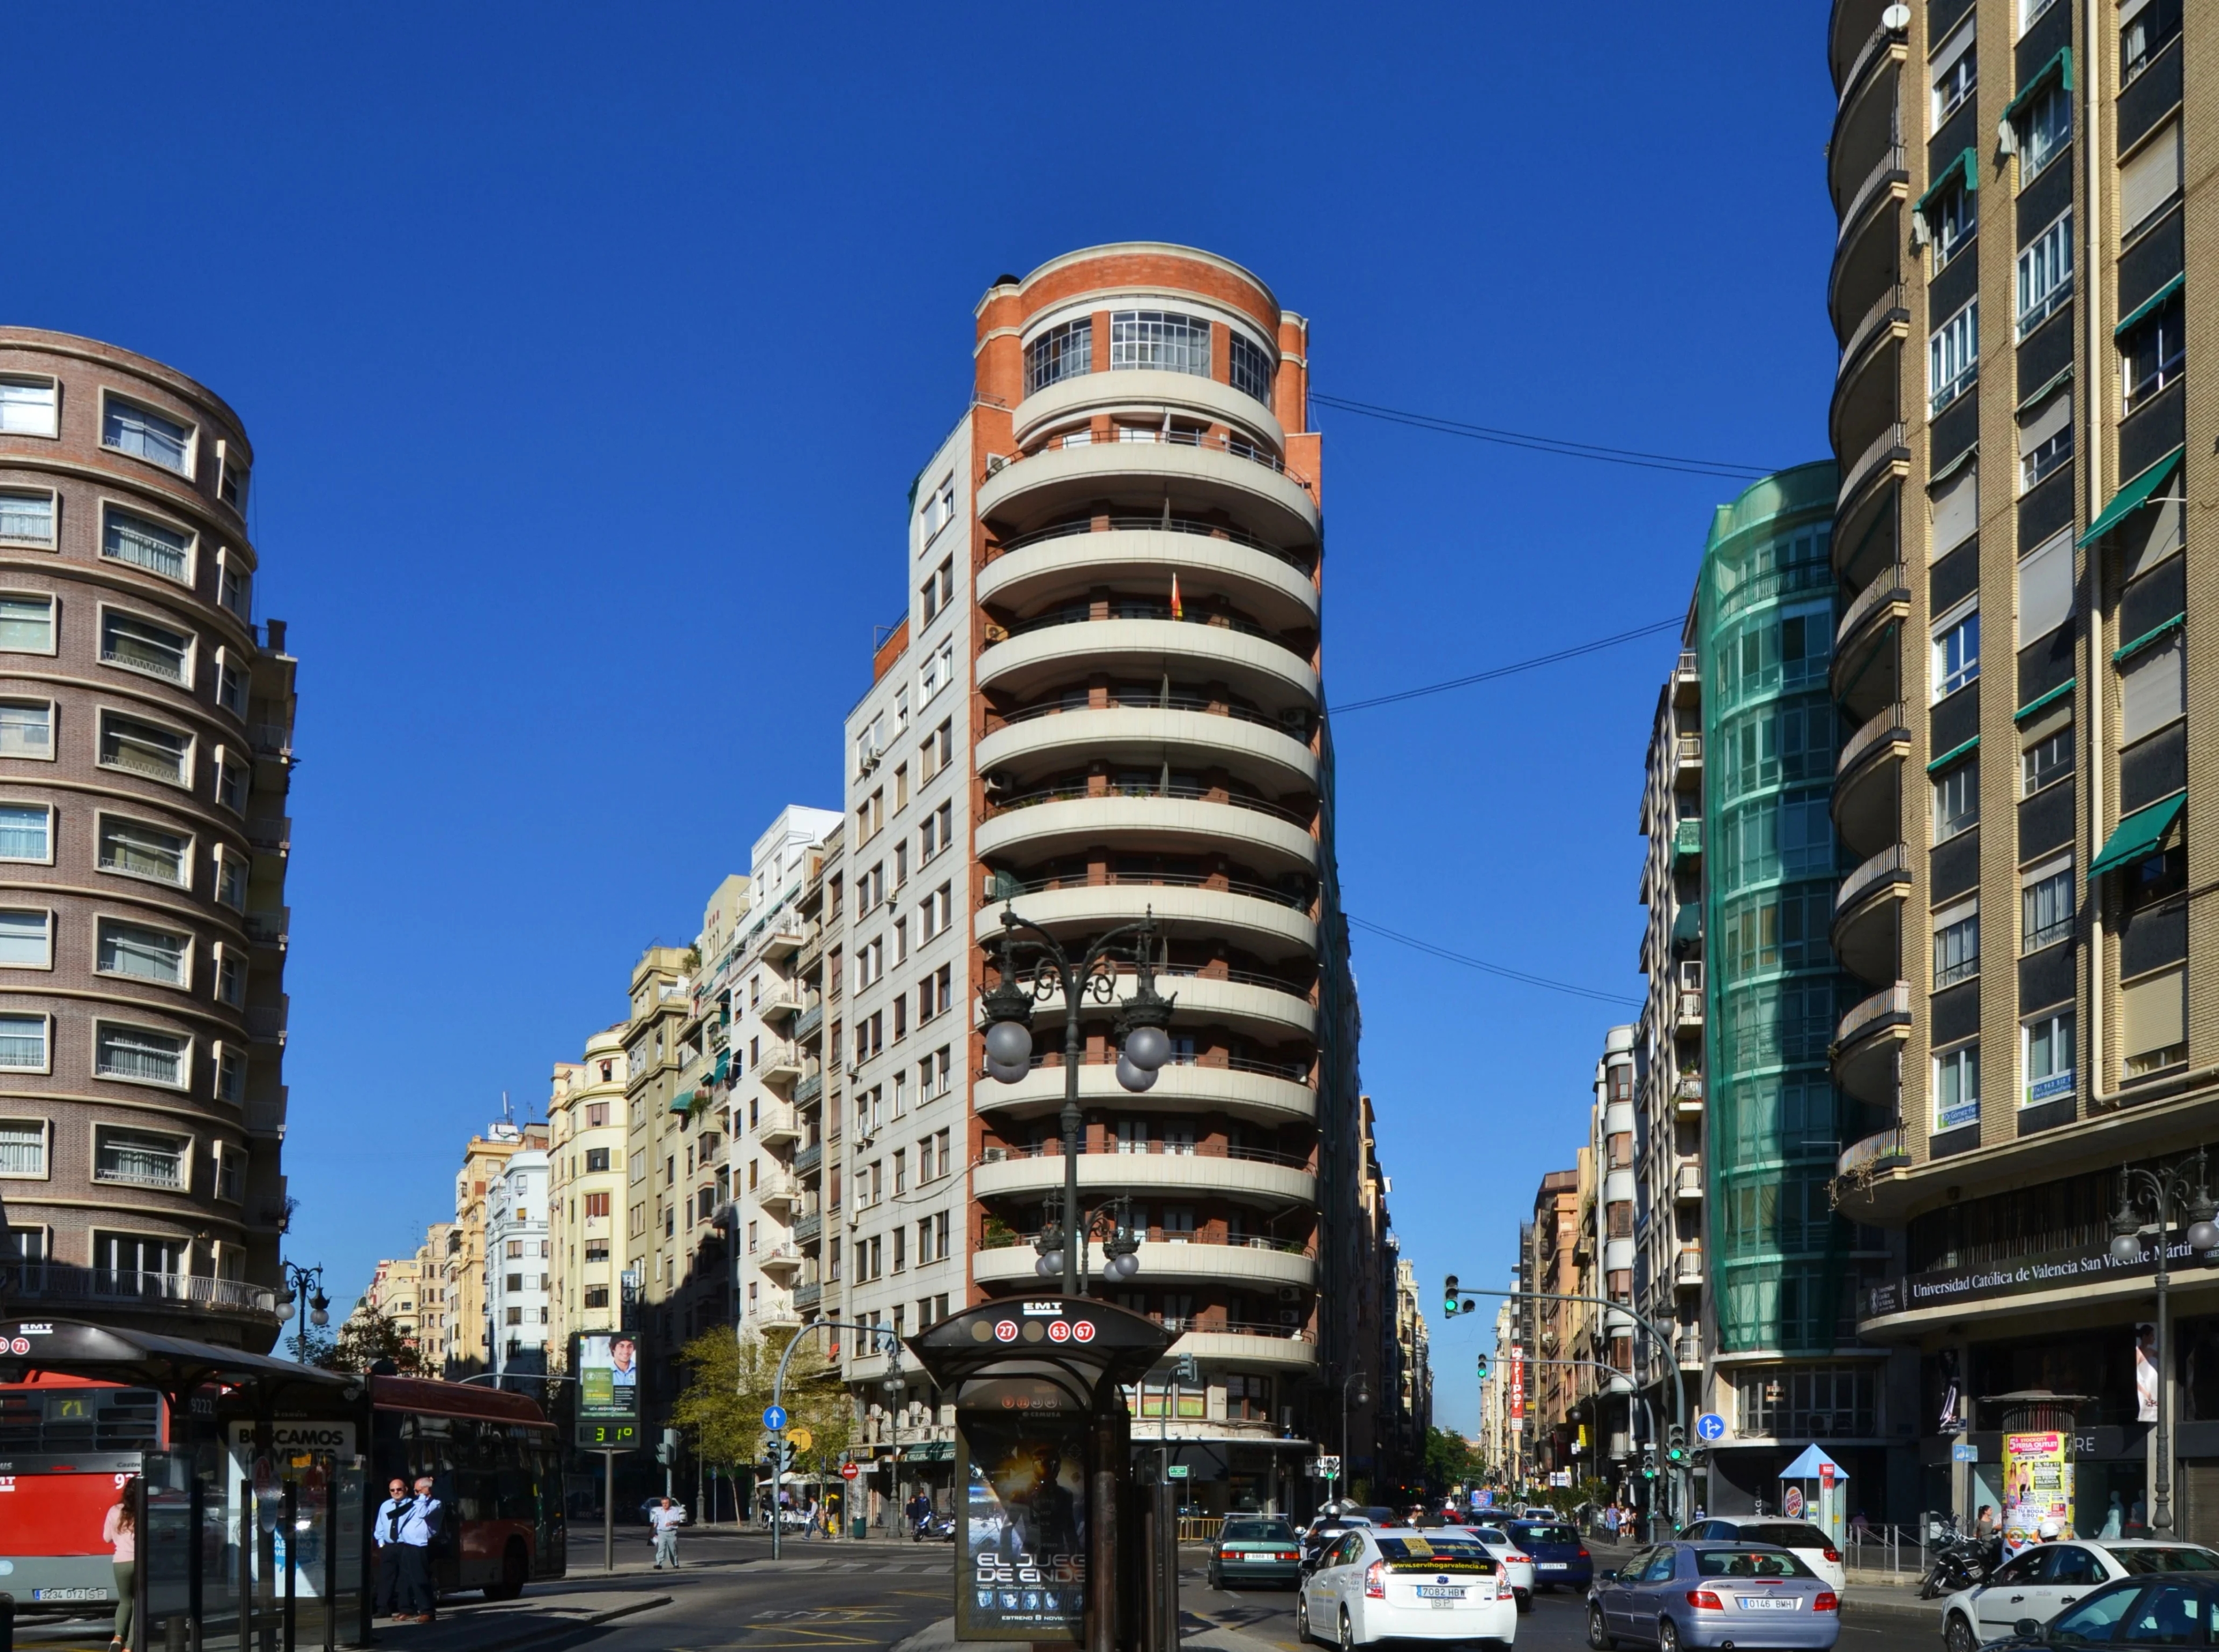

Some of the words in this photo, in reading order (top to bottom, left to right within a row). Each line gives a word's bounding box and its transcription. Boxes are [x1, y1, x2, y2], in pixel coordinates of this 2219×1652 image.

[1913, 1278, 1970, 1298] Universidad
[1972, 1271, 2013, 1289] Católica
[2016, 1267, 2030, 1282] de
[2031, 1260, 2078, 1279] Valencia
[2081, 1256, 2102, 1272] San
[999, 1326, 1012, 1337] 27
[1052, 1326, 1067, 1337] 63
[1077, 1326, 1090, 1337] 67
[15, 1342, 25, 1350] 71
[61, 1401, 83, 1416] 71
[191, 1397, 213, 1414] 9222
[1787, 1493, 1801, 1503] BURGER
[1787, 1499, 1801, 1512] KING
[977, 1553, 1011, 1566] EL
[1391, 1562, 1487, 1570] www.servihogarvalencia.es
[977, 1568, 1014, 1582] DE
[42, 1591, 62, 1599] 3234
[66, 1591, 83, 1599] DYZ
[1423, 1588, 1445, 1596] 7082
[1750, 1599, 1771, 1608] 0146
